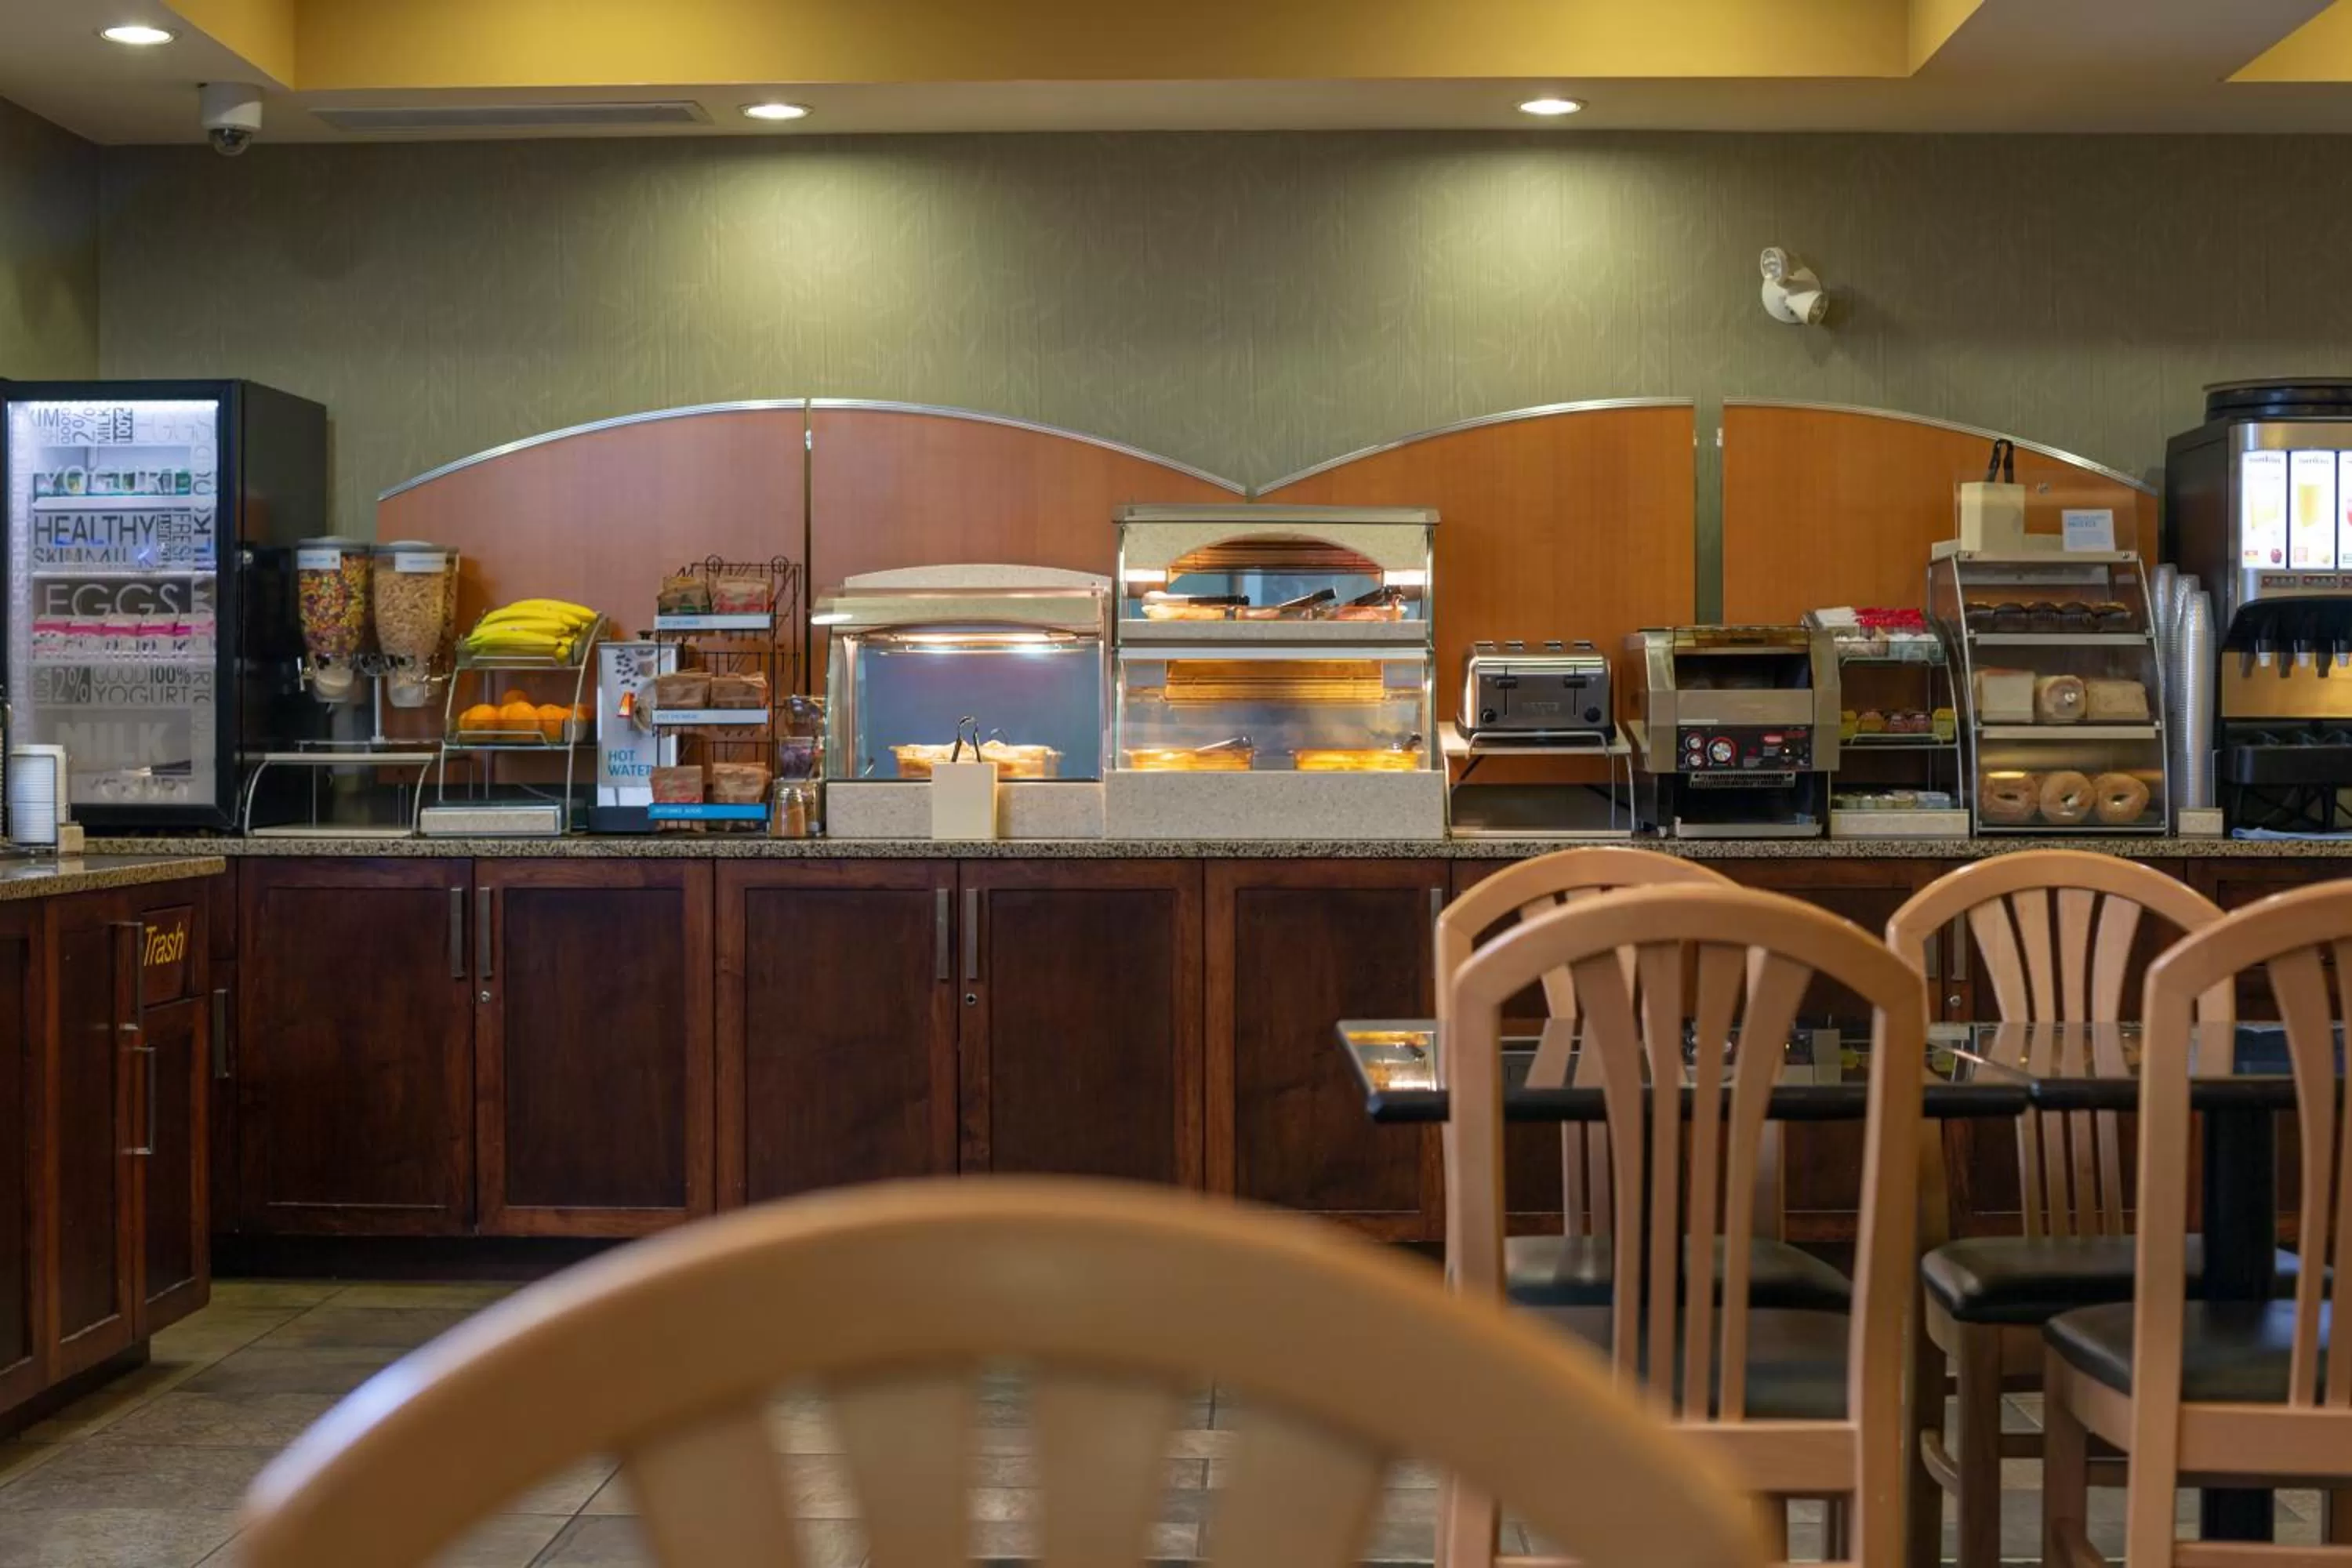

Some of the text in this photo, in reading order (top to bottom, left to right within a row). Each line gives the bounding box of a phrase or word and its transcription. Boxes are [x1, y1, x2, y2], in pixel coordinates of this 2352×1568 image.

[72, 406, 96, 445] 2%
[97, 407, 111, 444] MILK
[34, 516, 155, 546] HEALTHY
[45, 583, 180, 618] EGGS
[54, 669, 89, 702] 2%
[150, 666, 191, 684] 100%
[93, 686, 189, 703] YOGURT
[56, 720, 170, 763] MILK
[608, 750, 635, 762] HOT
[143, 921, 184, 967] Trash
